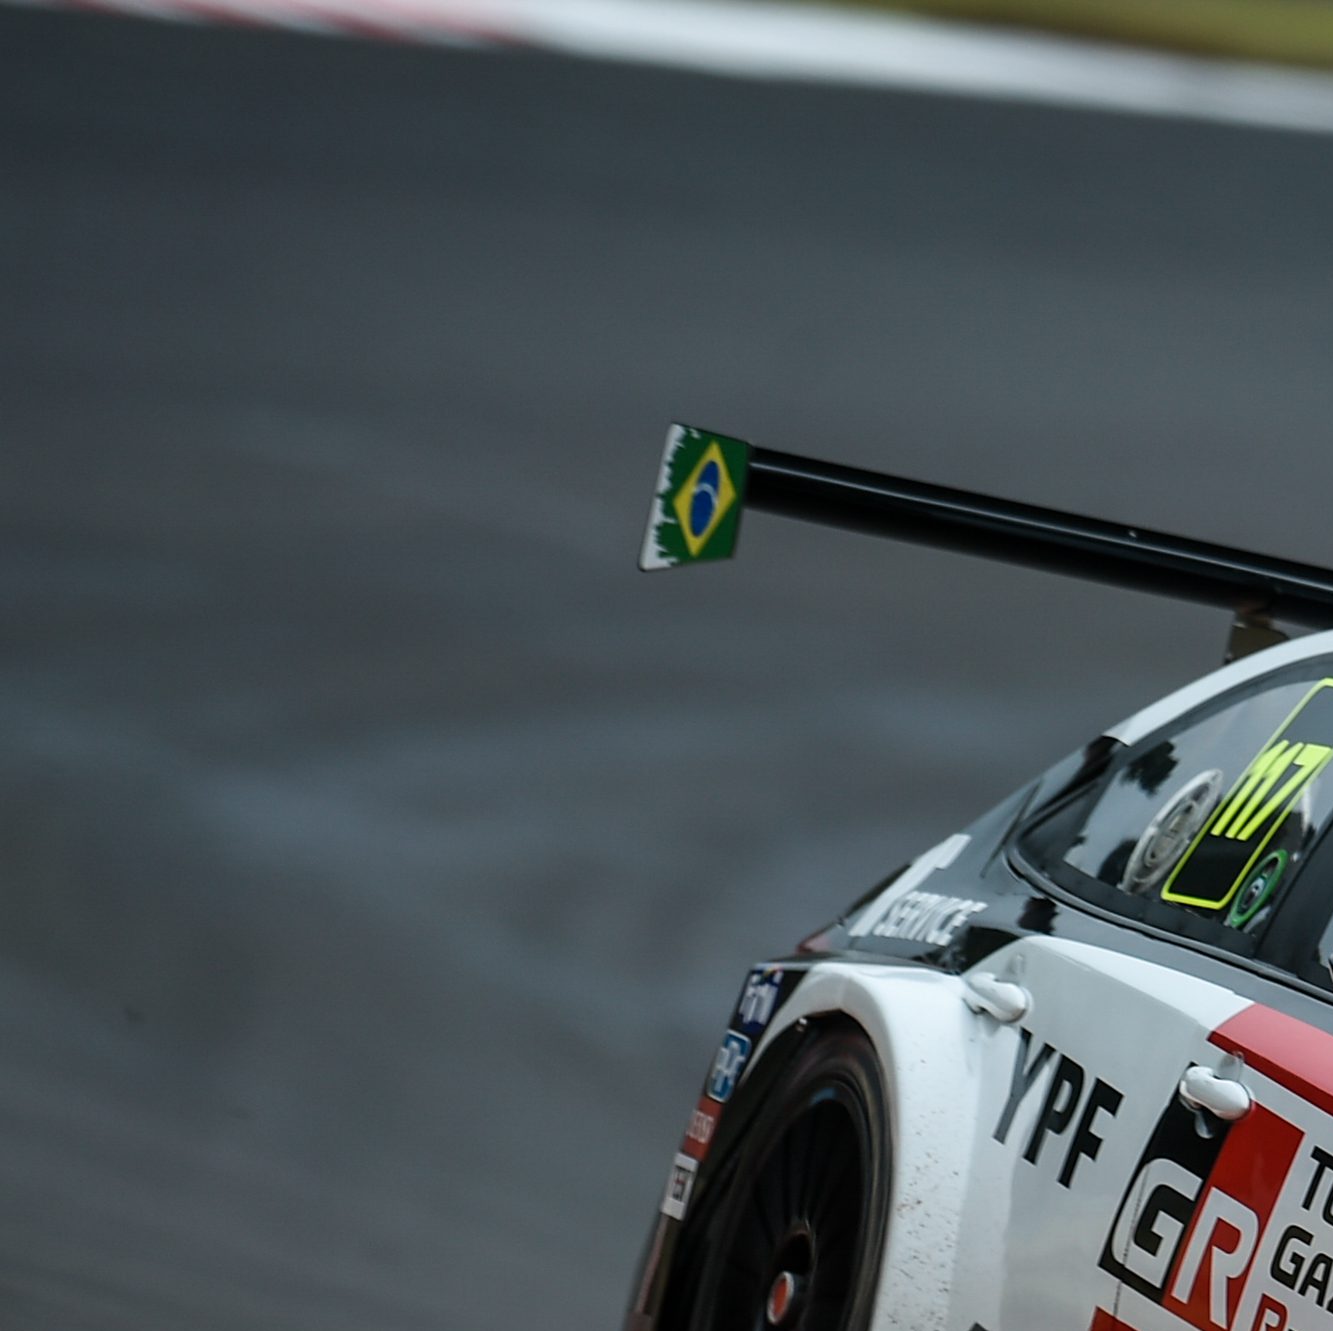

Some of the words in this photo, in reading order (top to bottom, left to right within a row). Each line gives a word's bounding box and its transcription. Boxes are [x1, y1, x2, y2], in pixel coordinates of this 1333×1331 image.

[1210, 739, 1332, 842] 117
[991, 1026, 1125, 1190] YPF
[1111, 1157, 1260, 1331] GR
